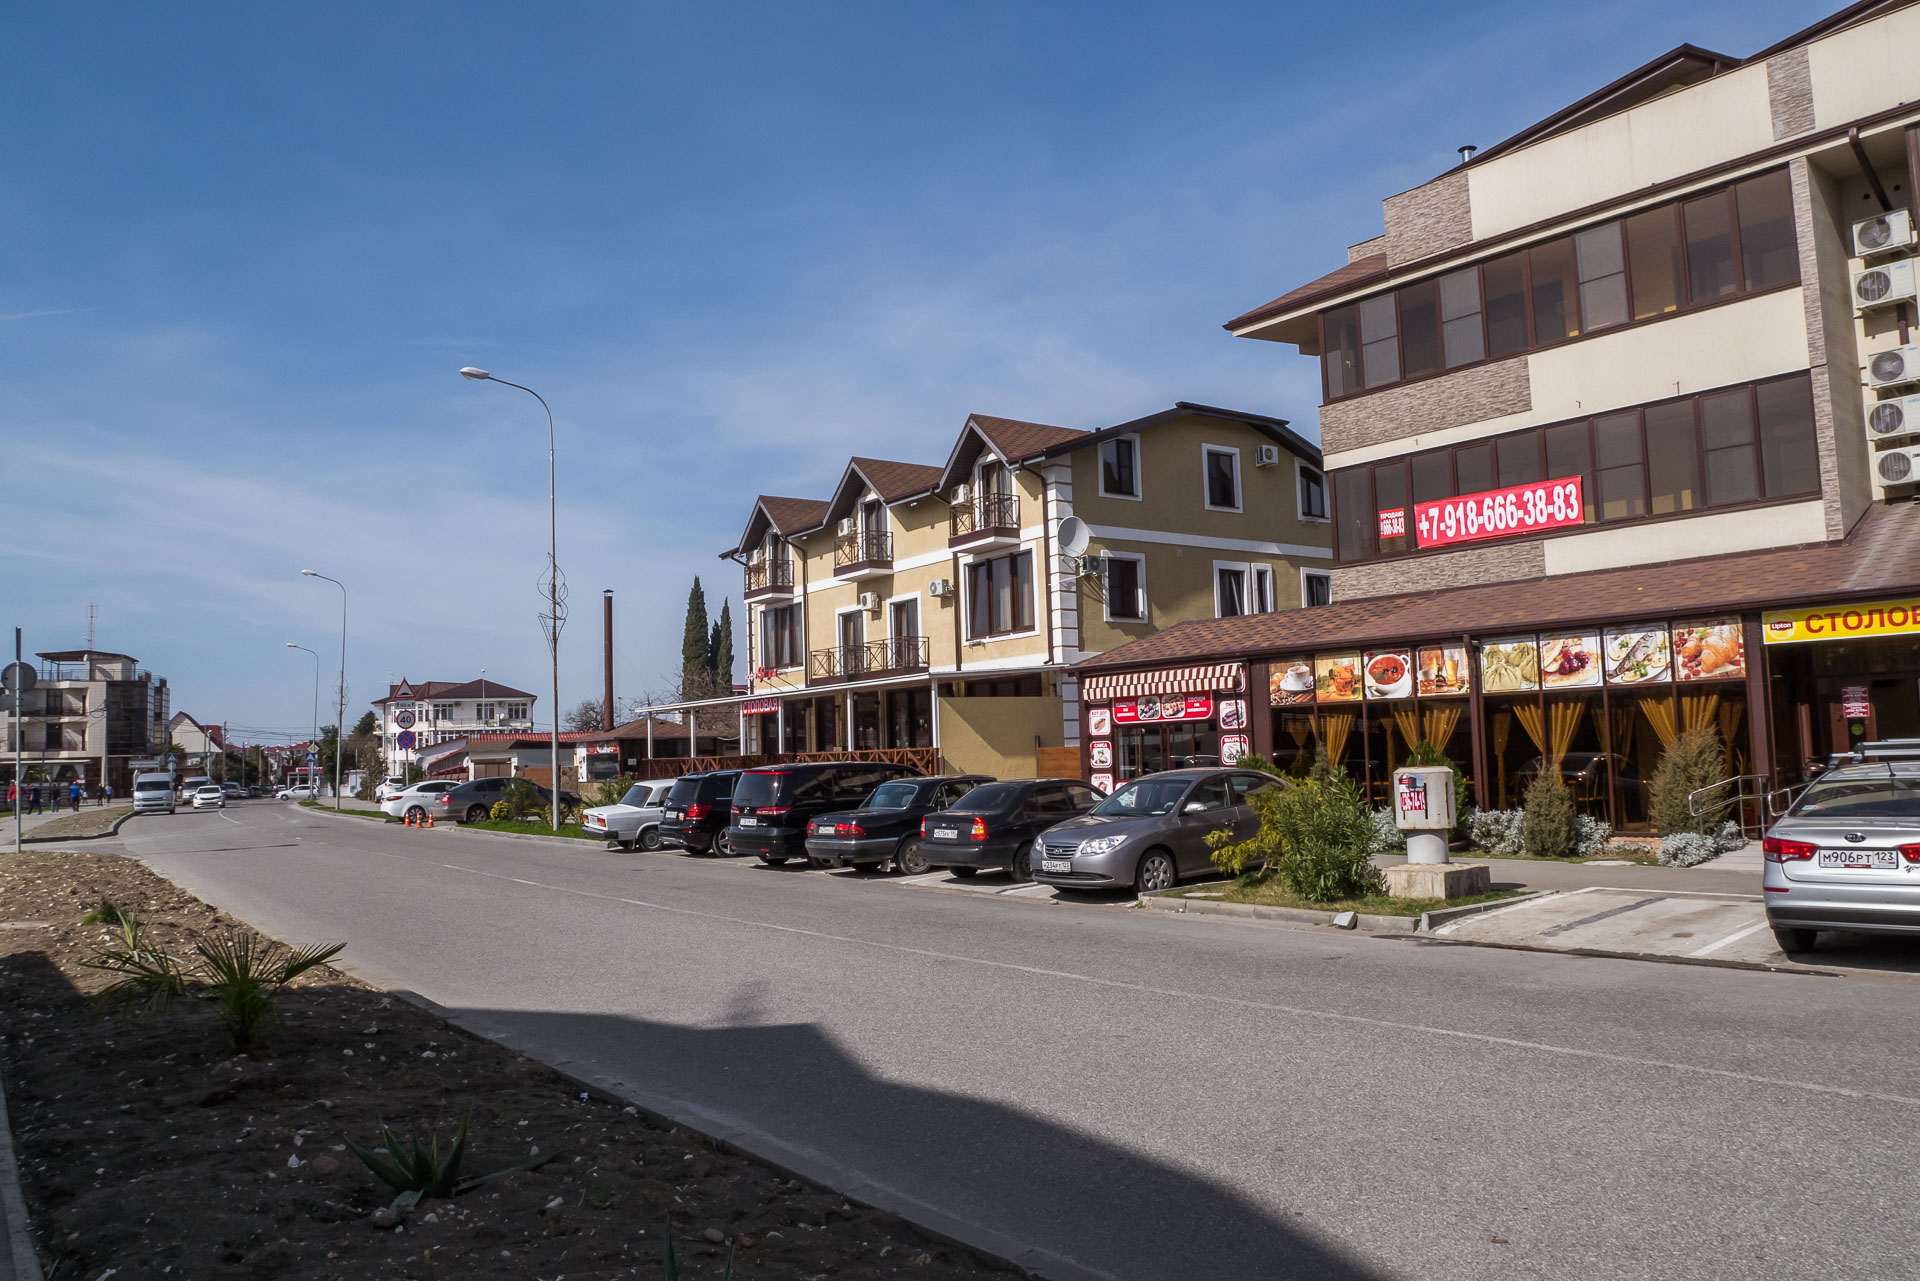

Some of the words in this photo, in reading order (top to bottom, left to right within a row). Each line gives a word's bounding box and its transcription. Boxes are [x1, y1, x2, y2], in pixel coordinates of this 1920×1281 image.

[1380, 510, 1404, 520] ПРОДАЮ
[1418, 483, 1579, 540] +7-918-666-38-83
[1771, 622, 1792, 630] Lipton
[743, 697, 778, 714] СТОЛОВАЯ
[1822, 851, 1872, 864] М906РТ
[1874, 851, 1896, 861] 123
